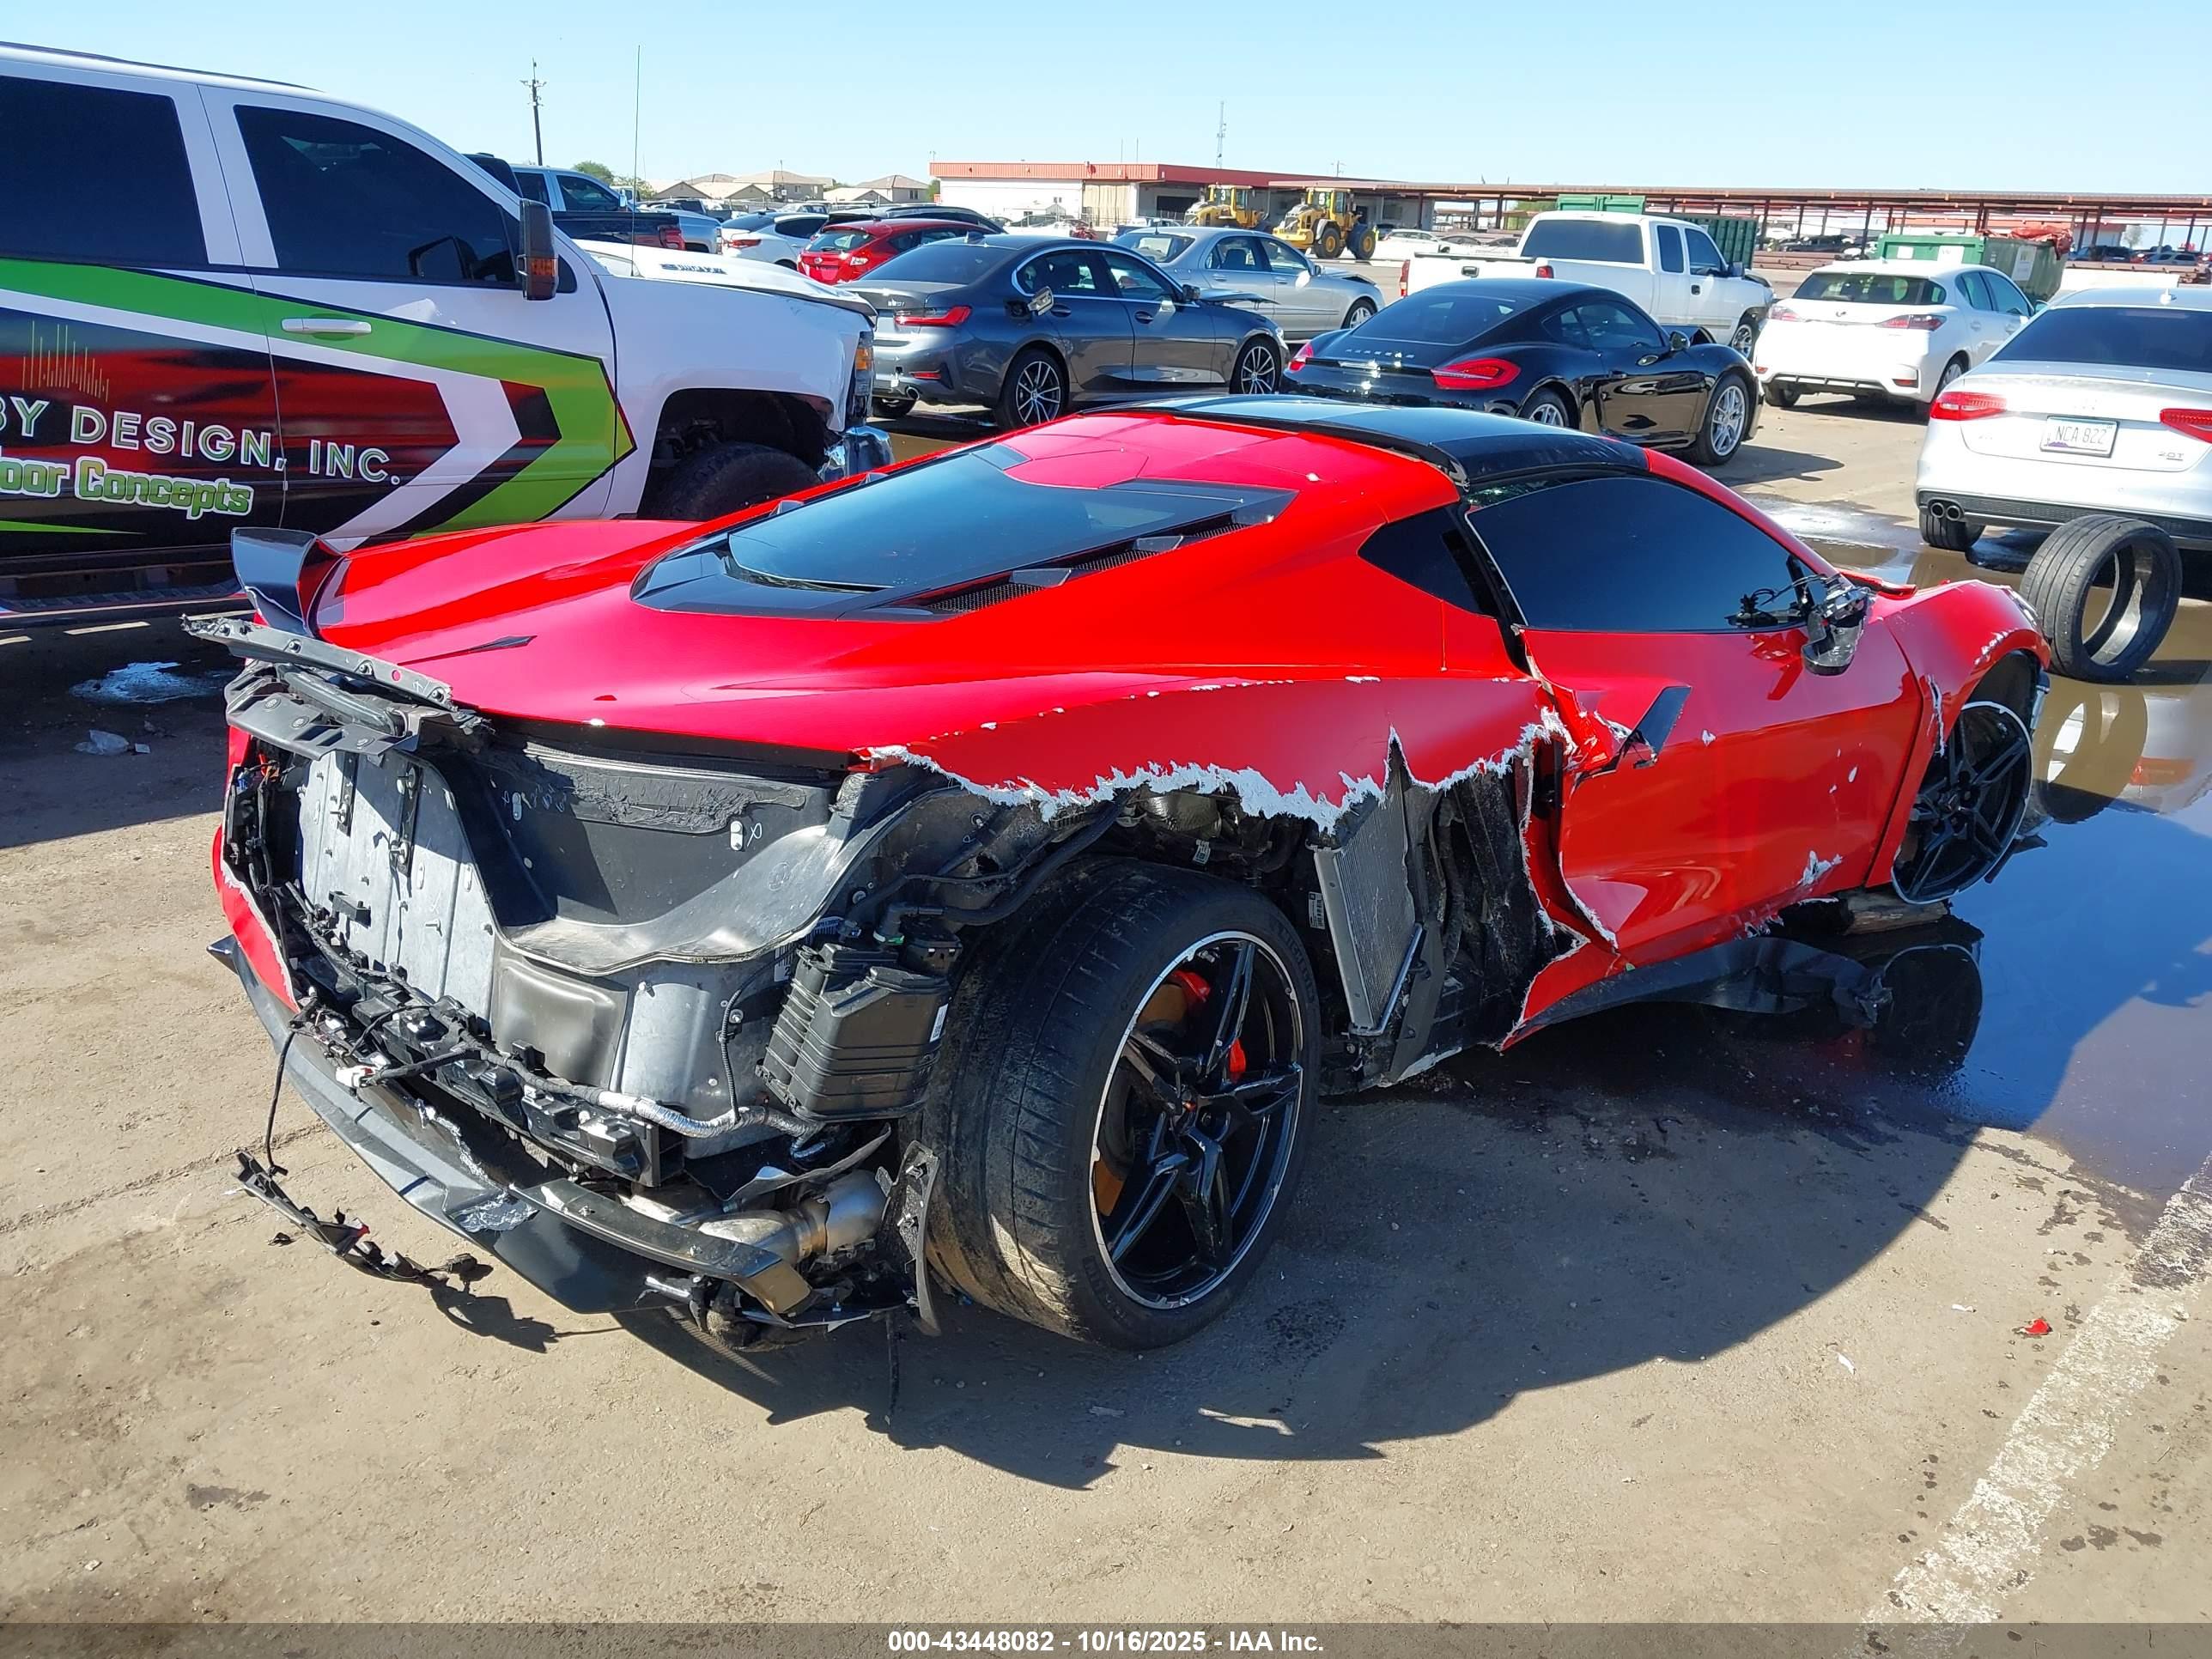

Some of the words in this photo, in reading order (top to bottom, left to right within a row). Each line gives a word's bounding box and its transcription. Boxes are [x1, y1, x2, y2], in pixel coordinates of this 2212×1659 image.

[0, 396, 49, 437] Y
[70, 405, 288, 471] DESIGN,
[309, 439, 400, 485] INC.
[2056, 426, 2079, 441] NCA
[0, 455, 70, 497] oor
[76, 457, 253, 520] Concepts
